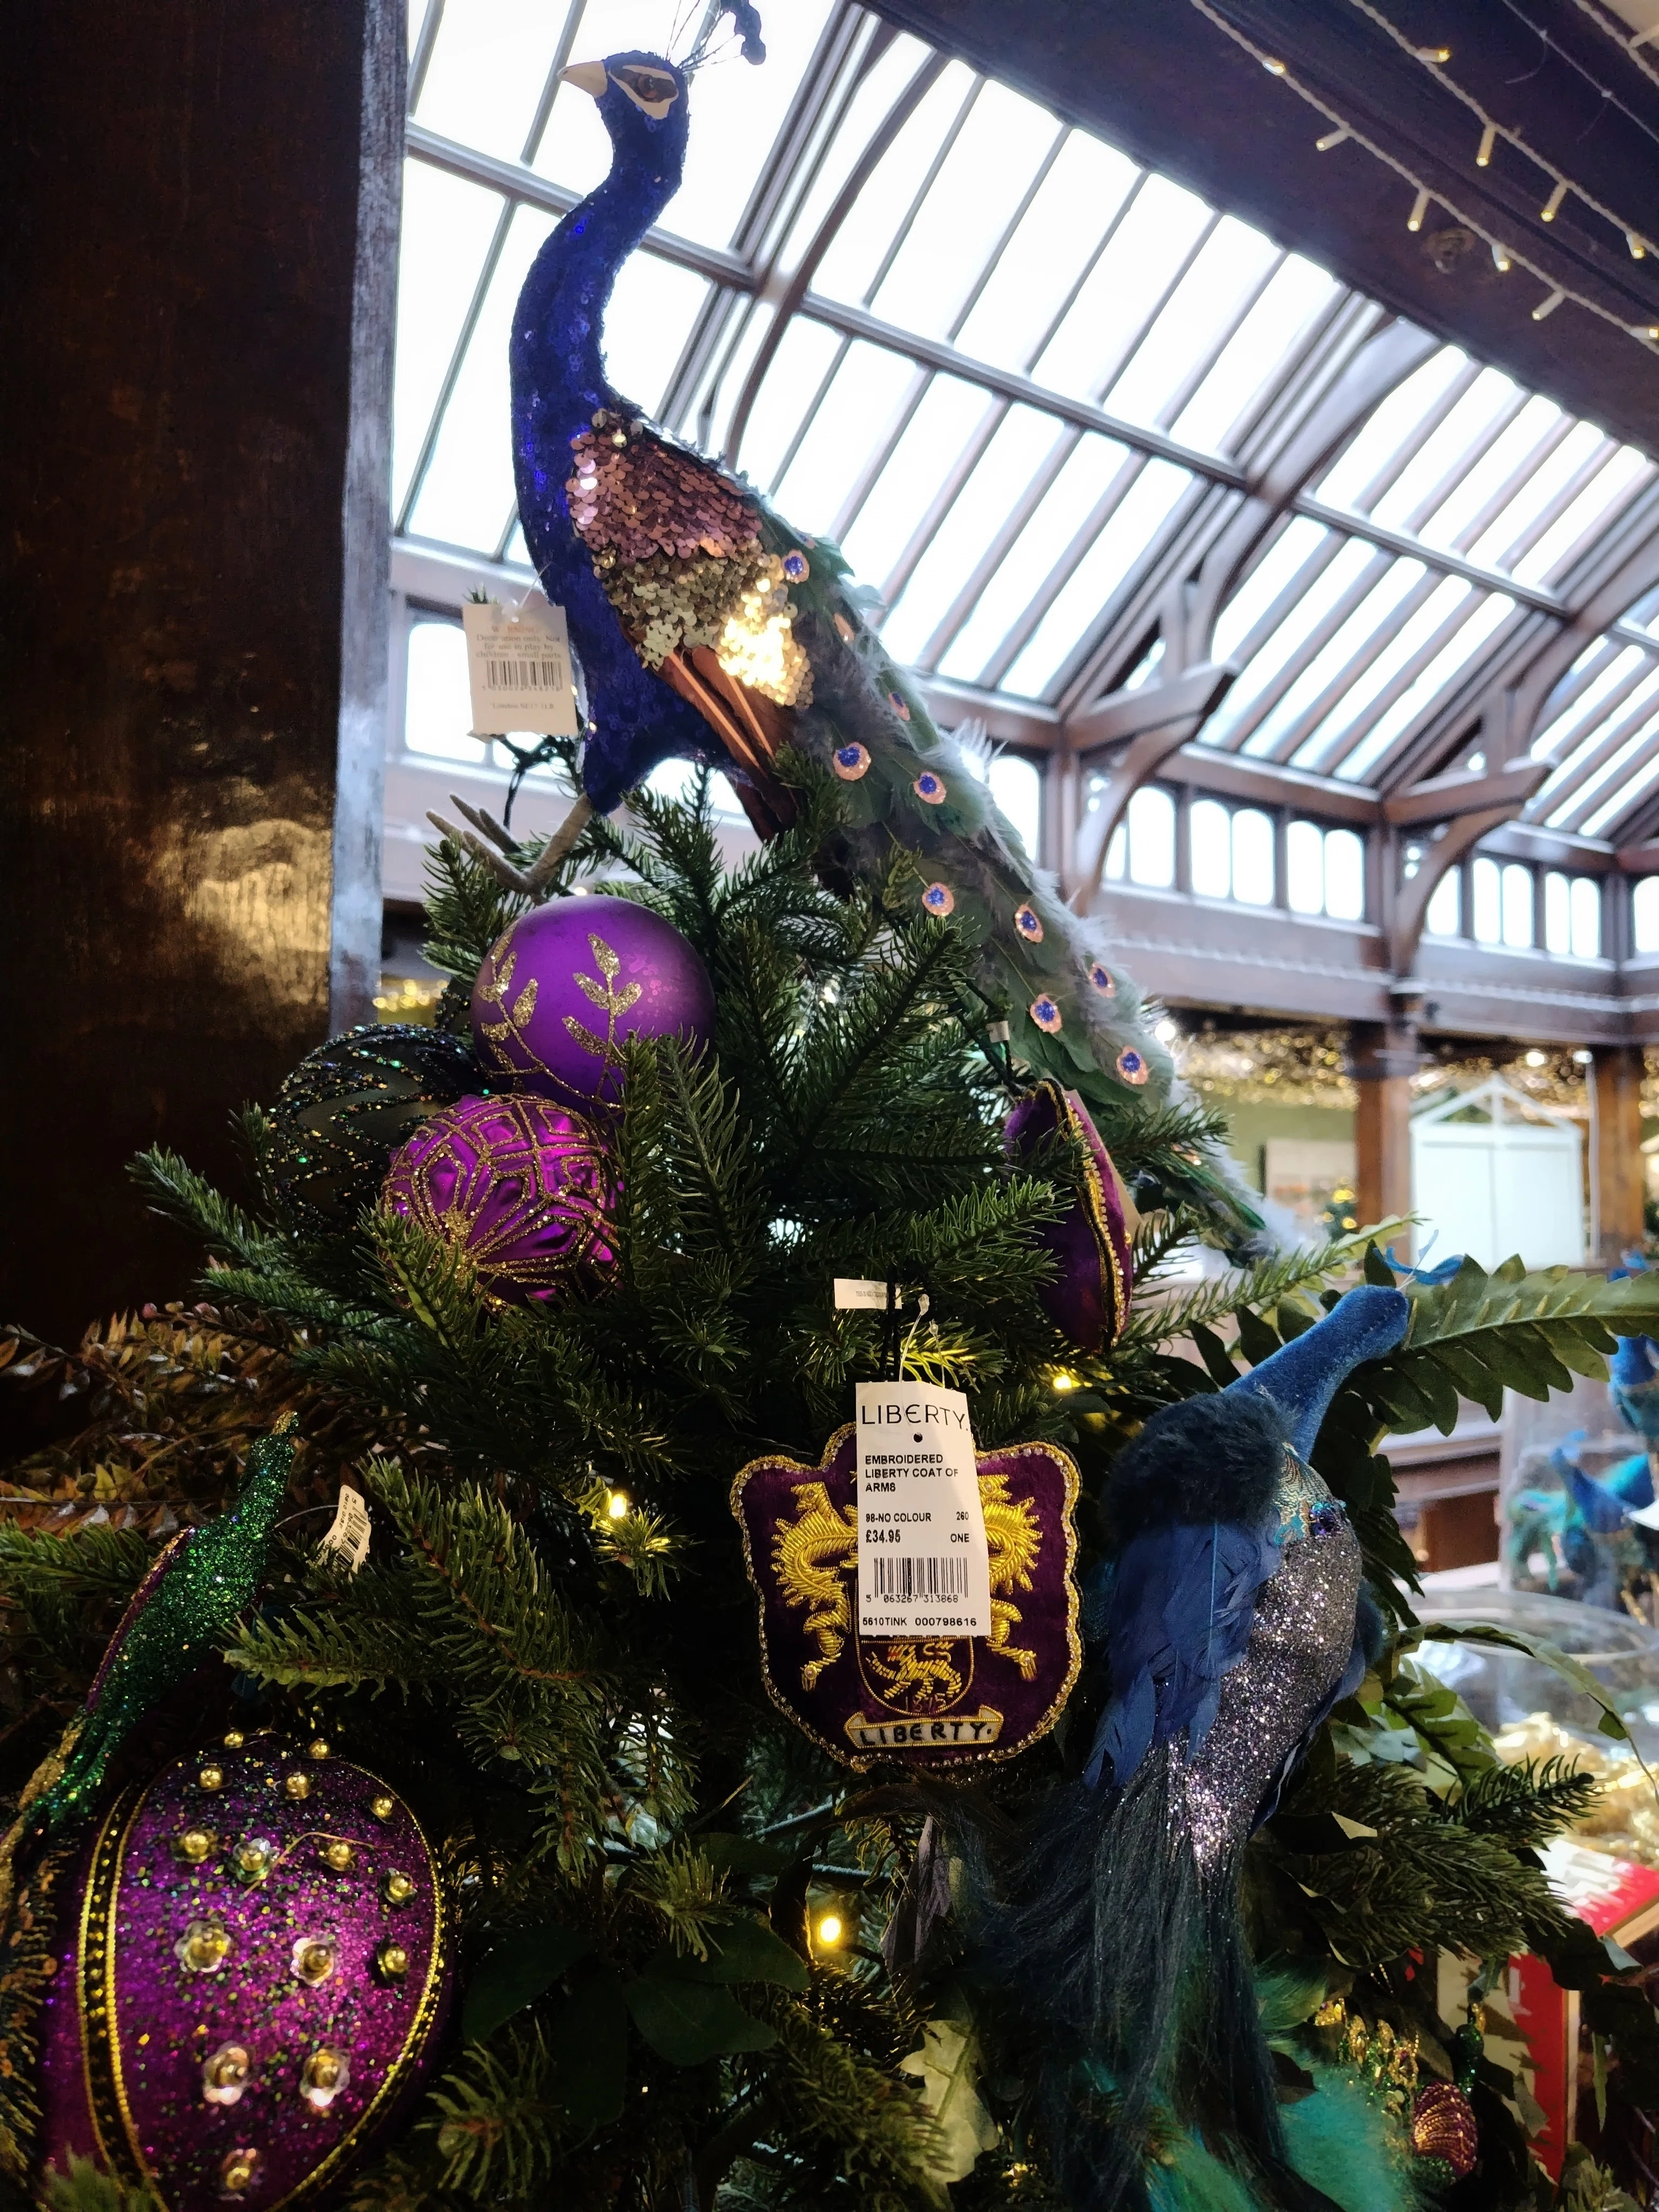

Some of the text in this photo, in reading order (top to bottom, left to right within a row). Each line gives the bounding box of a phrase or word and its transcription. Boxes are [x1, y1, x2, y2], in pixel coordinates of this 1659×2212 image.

[865, 1454, 943, 1465] EMBROIDERED
[865, 1468, 959, 1479] LIBERTY COAT OF
[865, 1482, 896, 1493] ARMS
[866, 1512, 932, 1523] 98-NO COLOUR
[956, 1511, 969, 1521] 260
[866, 1529, 901, 1543] £34.95
[950, 1533, 970, 1543] ONE
[866, 1594, 959, 1603] 5 063267 313868
[862, 1617, 977, 1627] 5610TINK 000798616
